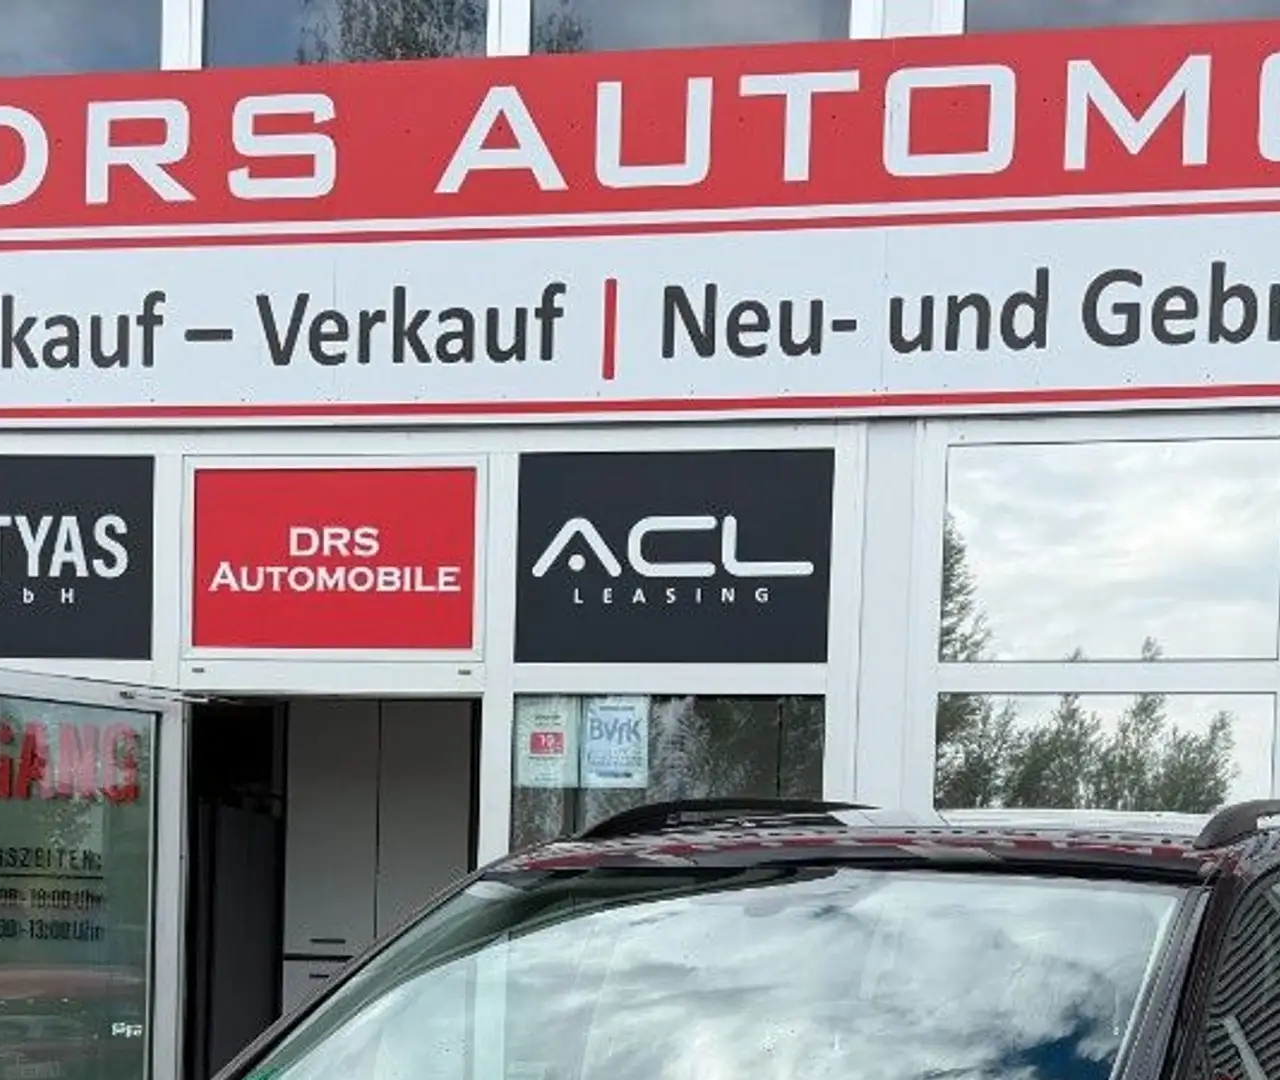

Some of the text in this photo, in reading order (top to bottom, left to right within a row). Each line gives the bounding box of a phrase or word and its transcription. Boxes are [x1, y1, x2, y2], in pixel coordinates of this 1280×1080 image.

[255, 281, 566, 366] Verkauf
[660, 280, 858, 360] Neu-
[887, 266, 1050, 352] und
[289, 526, 380, 557] DRS
[531, 515, 815, 577] ACL
[207, 562, 461, 592] AUTOMOBILE
[573, 588, 770, 604] LEASING
